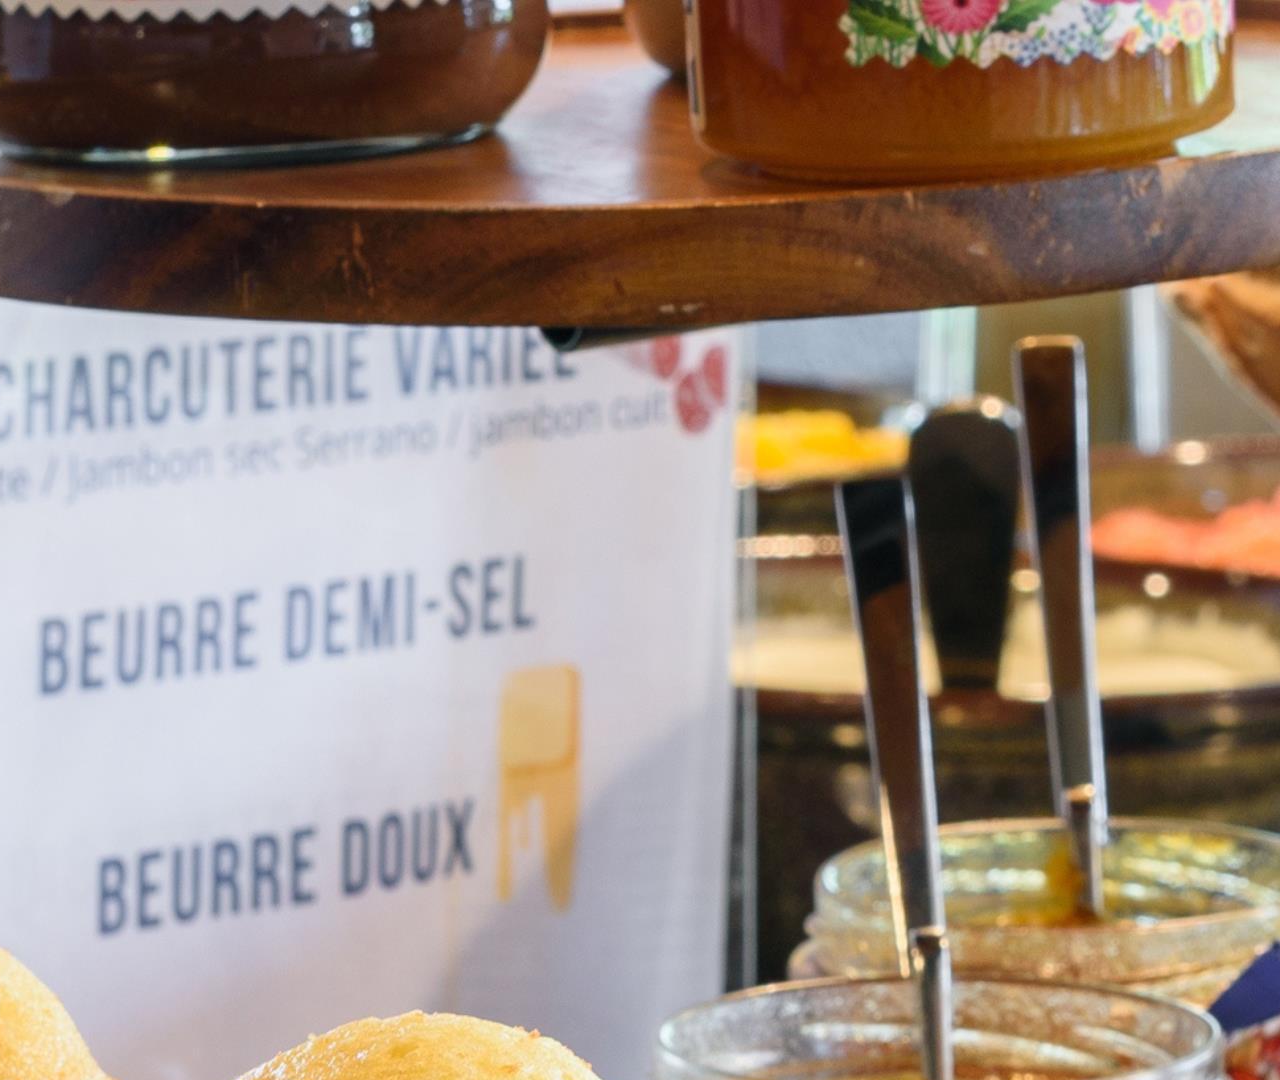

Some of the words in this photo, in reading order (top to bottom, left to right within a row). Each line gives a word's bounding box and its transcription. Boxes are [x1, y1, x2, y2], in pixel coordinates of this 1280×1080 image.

[226, 435, 282, 475] sec
[294, 418, 439, 470] Serrano
[466, 398, 602, 459] jambon
[607, 388, 666, 430] cuit
[39, 591, 260, 696] BEURRE
[284, 555, 536, 664] DEMI-SEL
[97, 825, 316, 937] BEURRE
[340, 797, 476, 897] DOUX
